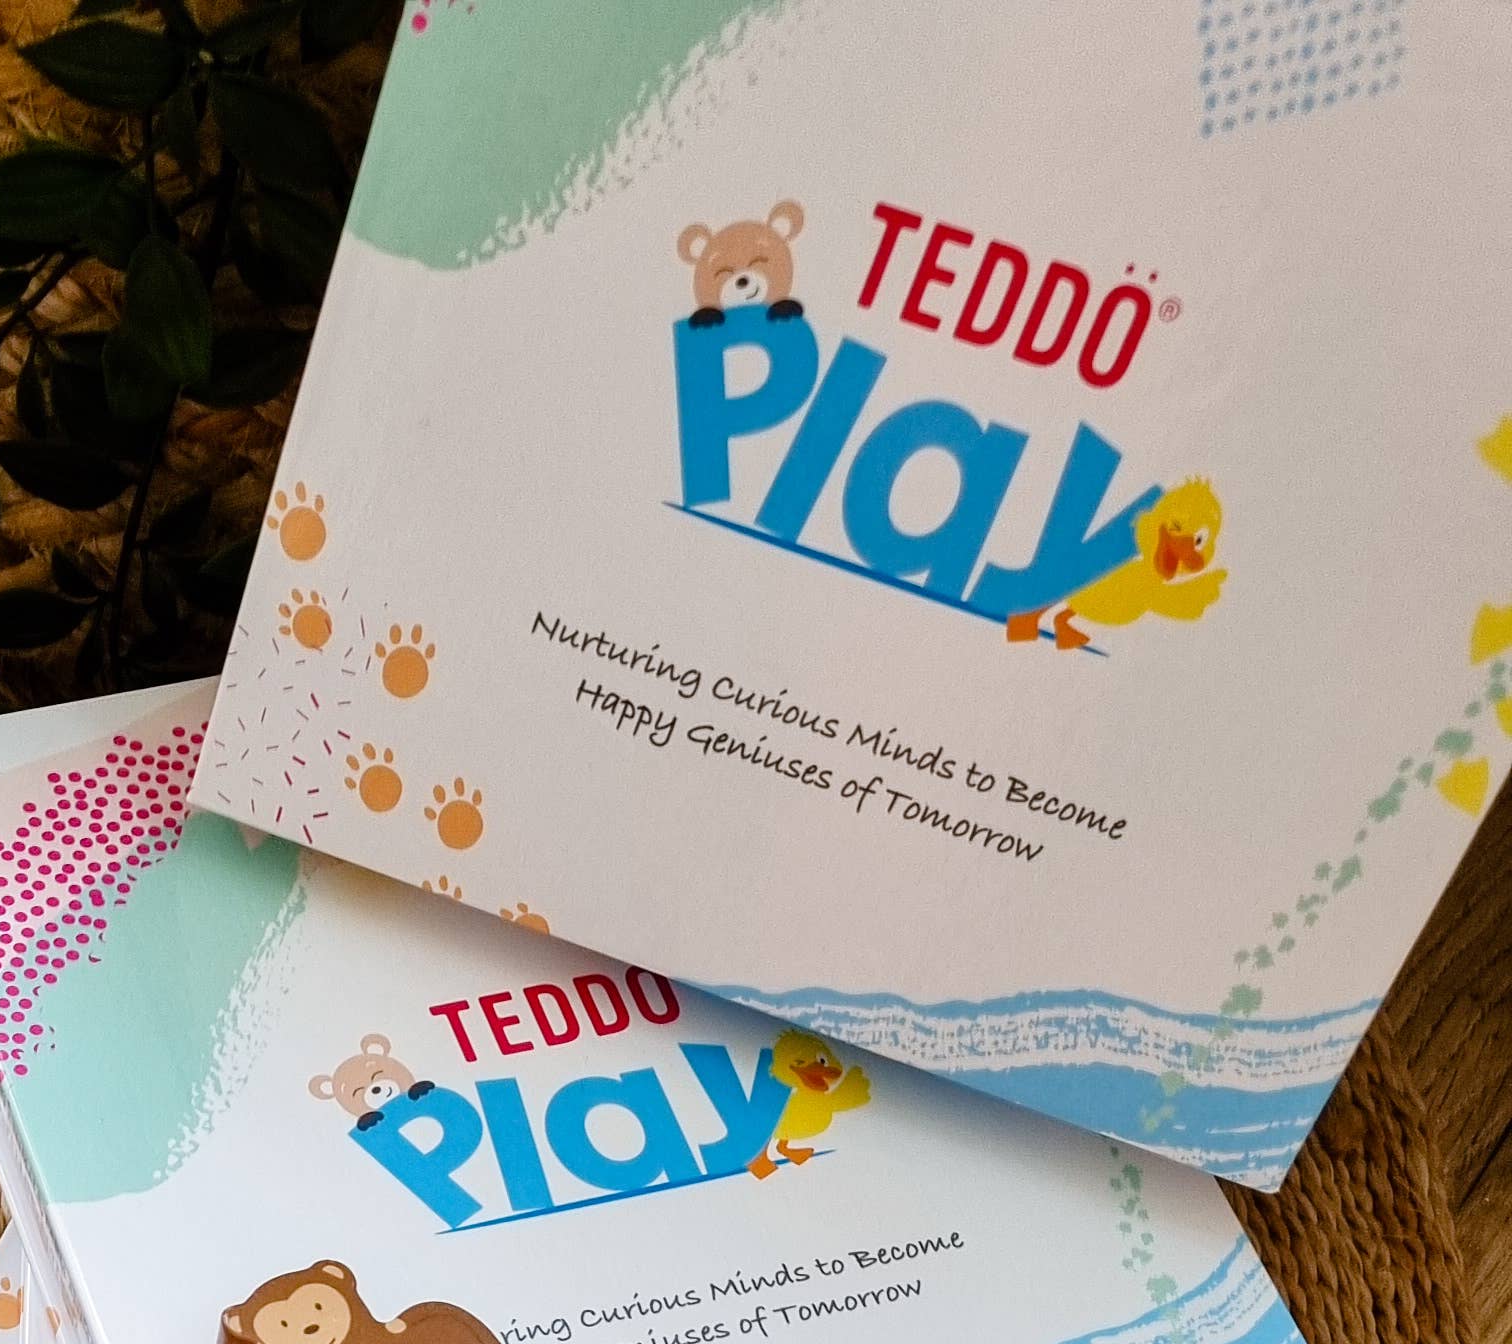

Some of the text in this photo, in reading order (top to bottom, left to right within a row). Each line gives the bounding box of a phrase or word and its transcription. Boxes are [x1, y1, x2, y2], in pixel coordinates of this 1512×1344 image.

[674, 303, 1164, 624] Play
[531, 611, 1128, 841] Nurturing Curious Minds to Become
[575, 678, 1045, 862] Happy Geniuses of Tomorrow
[349, 1043, 792, 1231] Play
[580, 1289, 702, 1328] Curious
[709, 1263, 811, 1302] Minds
[814, 1253, 845, 1278] to
[847, 1231, 965, 1269] Become
[739, 1305, 769, 1337] of
[772, 1279, 922, 1325] Tomorrow
